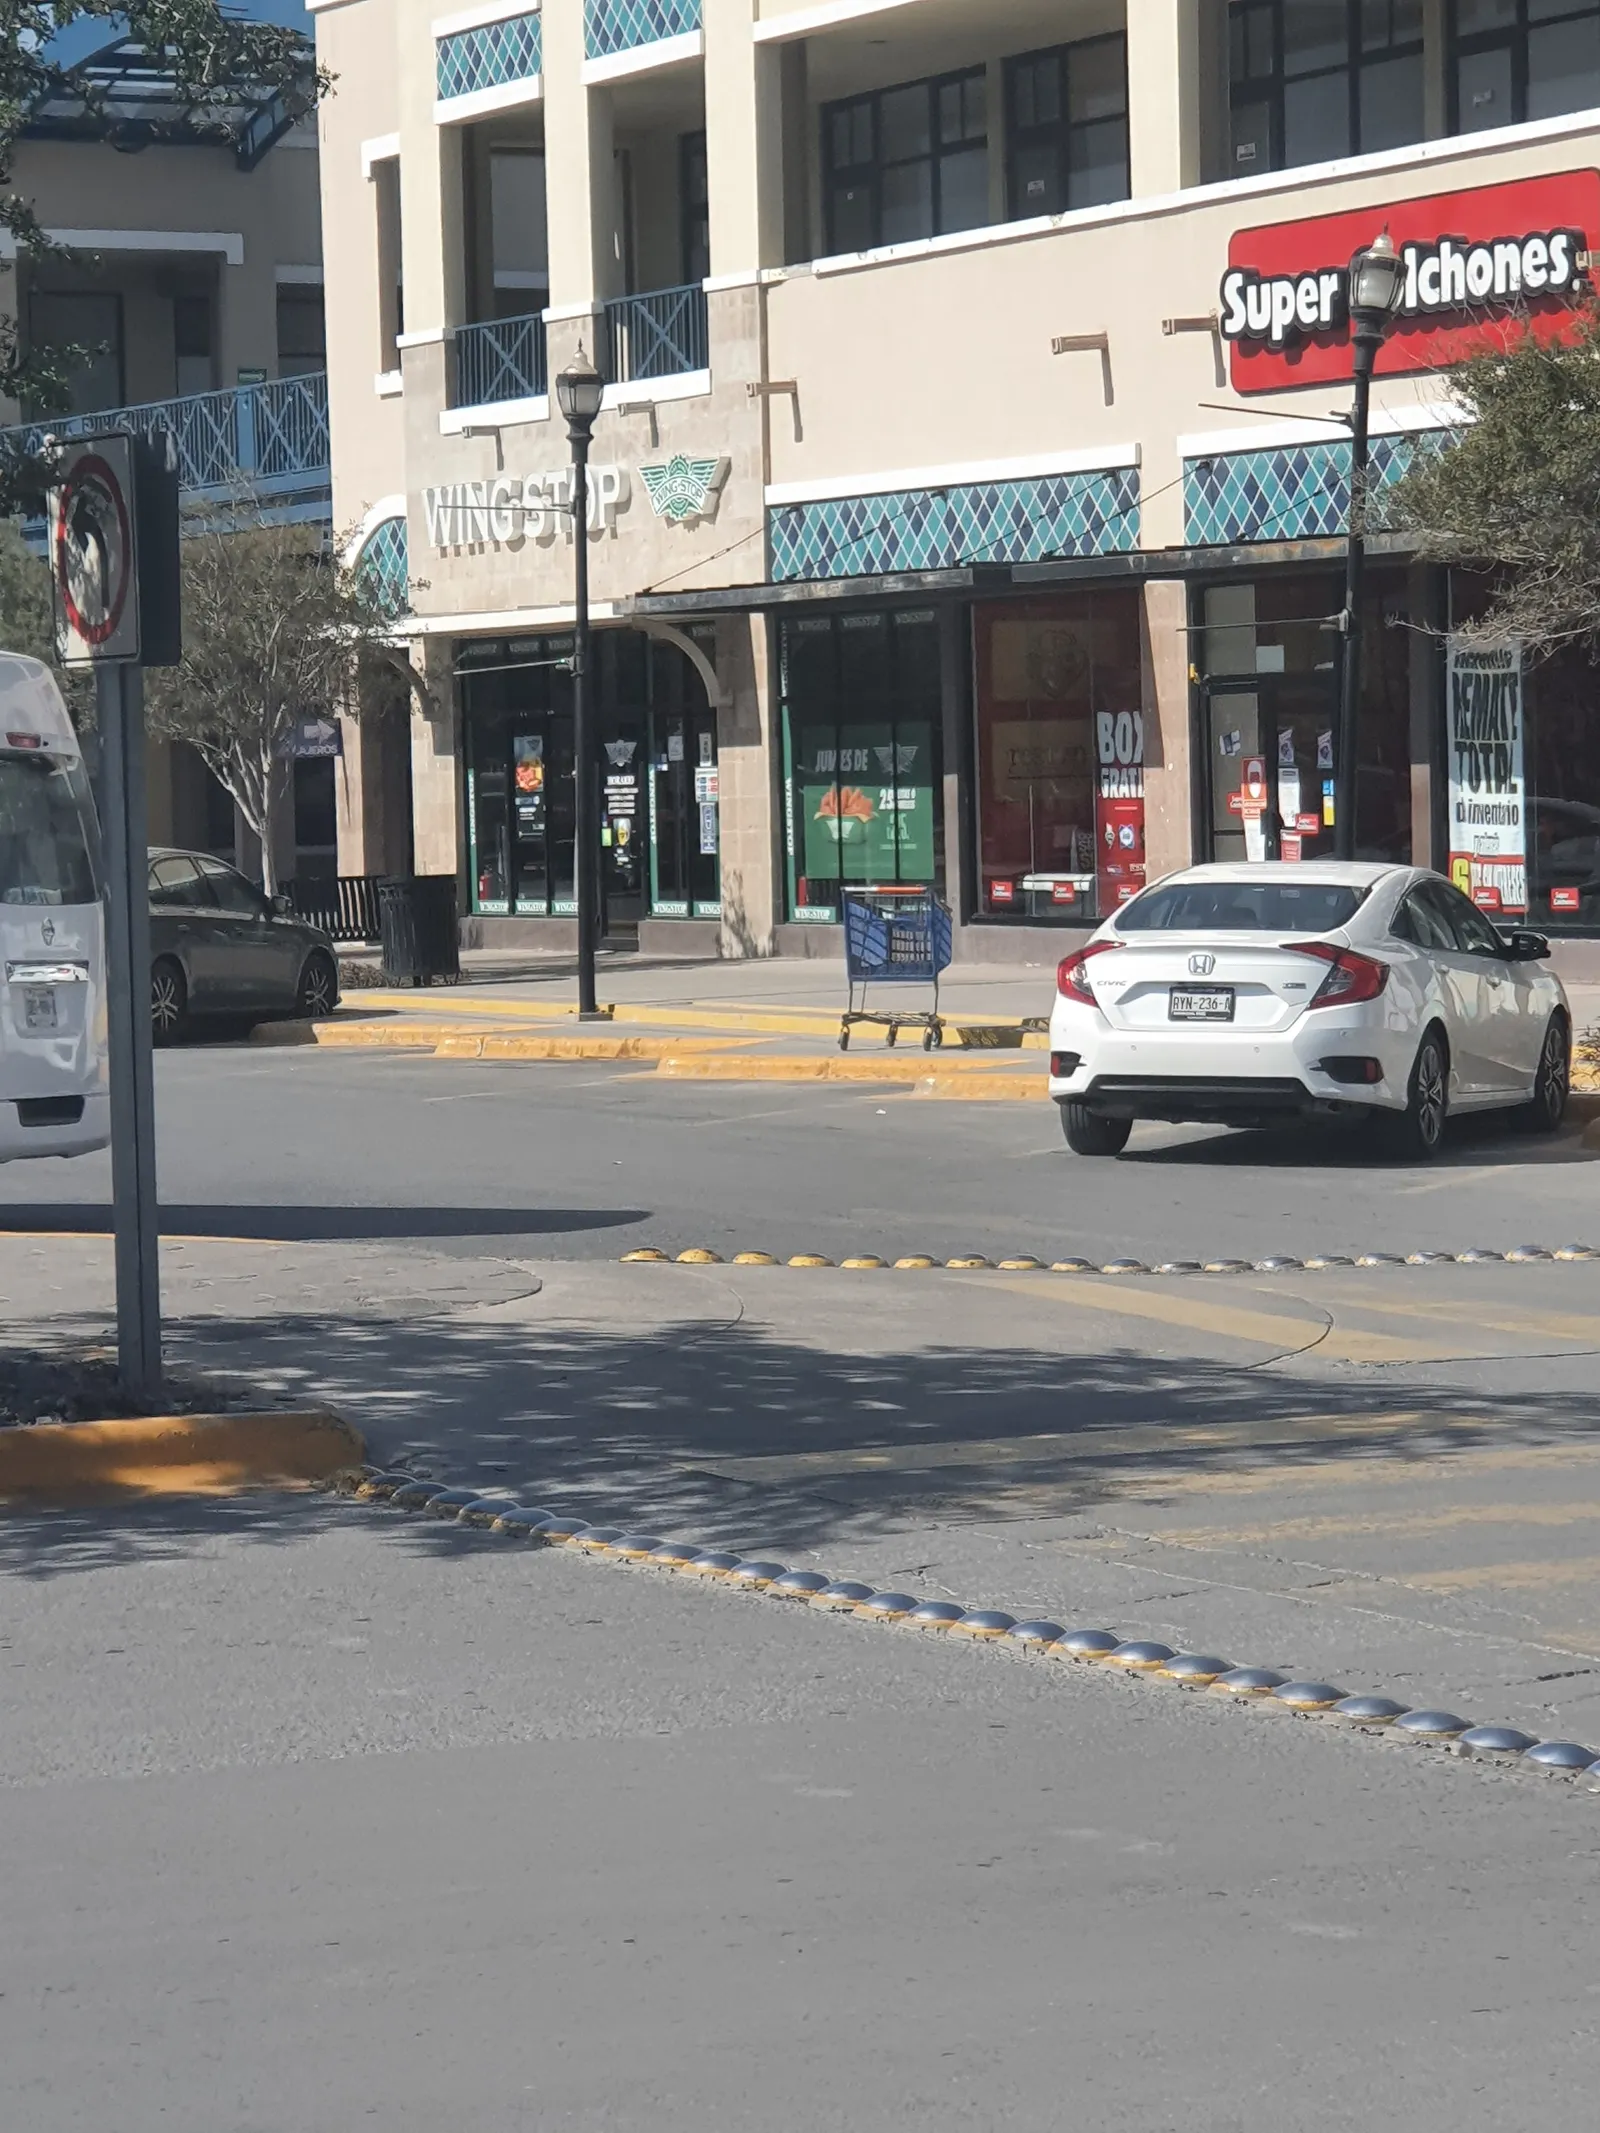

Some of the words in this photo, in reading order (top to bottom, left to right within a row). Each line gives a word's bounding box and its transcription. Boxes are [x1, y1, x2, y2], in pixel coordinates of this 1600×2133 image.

[1224, 271, 1338, 341] Super
[1101, 767, 1144, 798] GRATI
[1454, 741, 1518, 794] TOTAL
